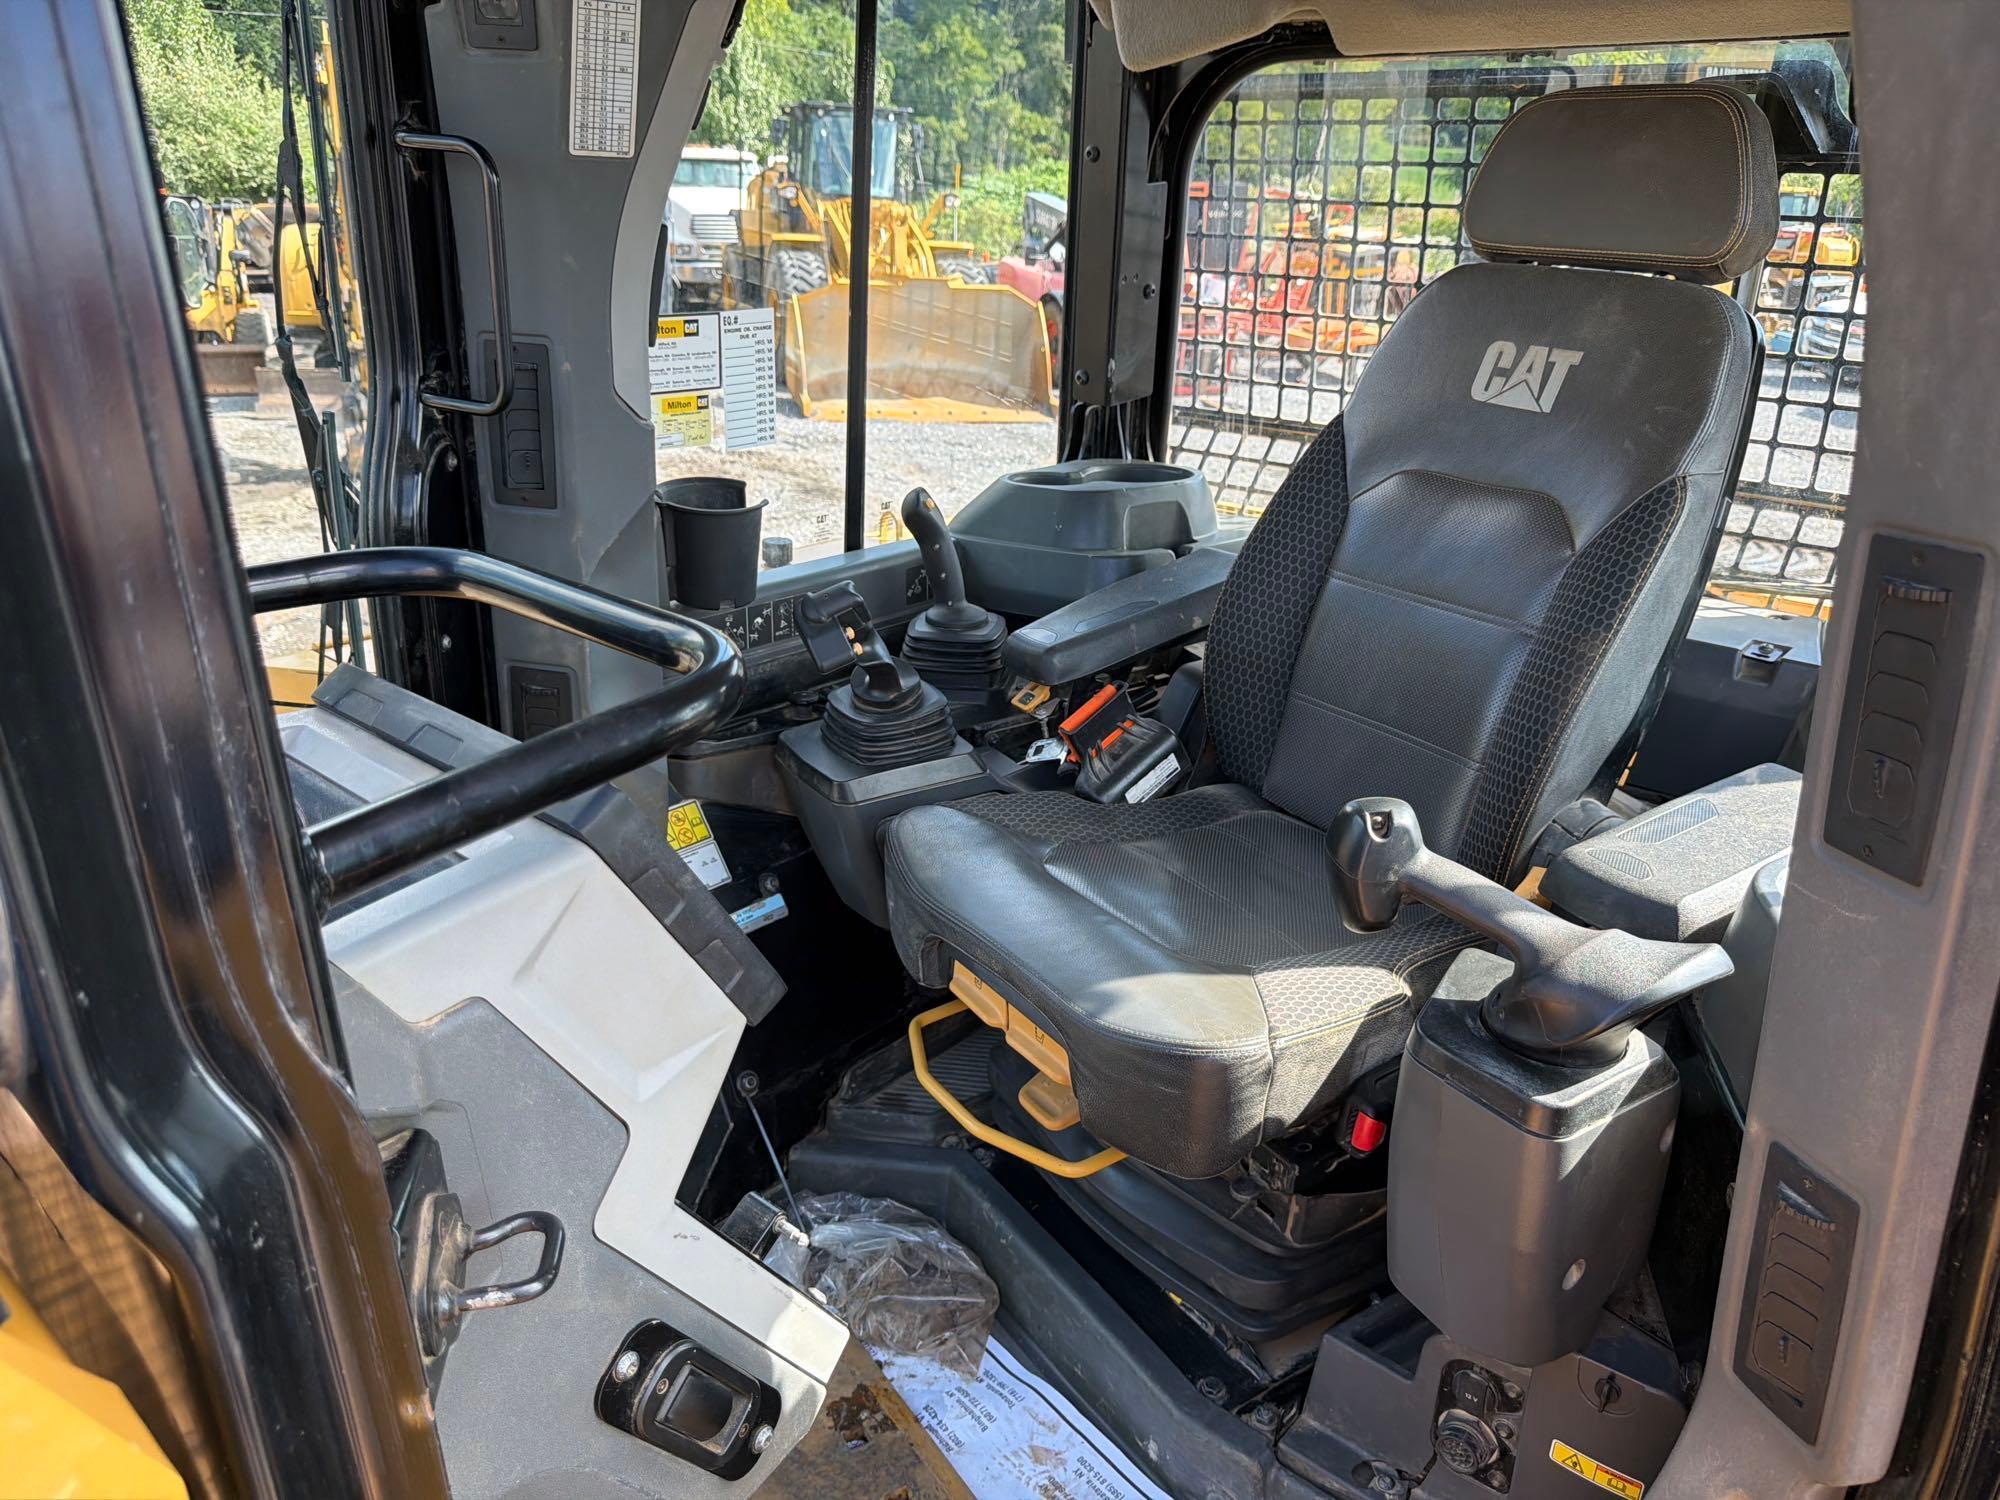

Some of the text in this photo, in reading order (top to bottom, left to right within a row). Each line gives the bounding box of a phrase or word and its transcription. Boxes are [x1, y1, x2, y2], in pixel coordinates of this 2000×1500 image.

[684, 323, 698, 333] CAT
[1471, 340, 1584, 413] CAT
[881, 502, 891, 510] CAT
[817, 515, 827, 524] CAT
[980, 1405, 998, 1423] (607)
[947, 1430, 965, 1448] (802)
[1072, 1468, 1085, 1478] NY
